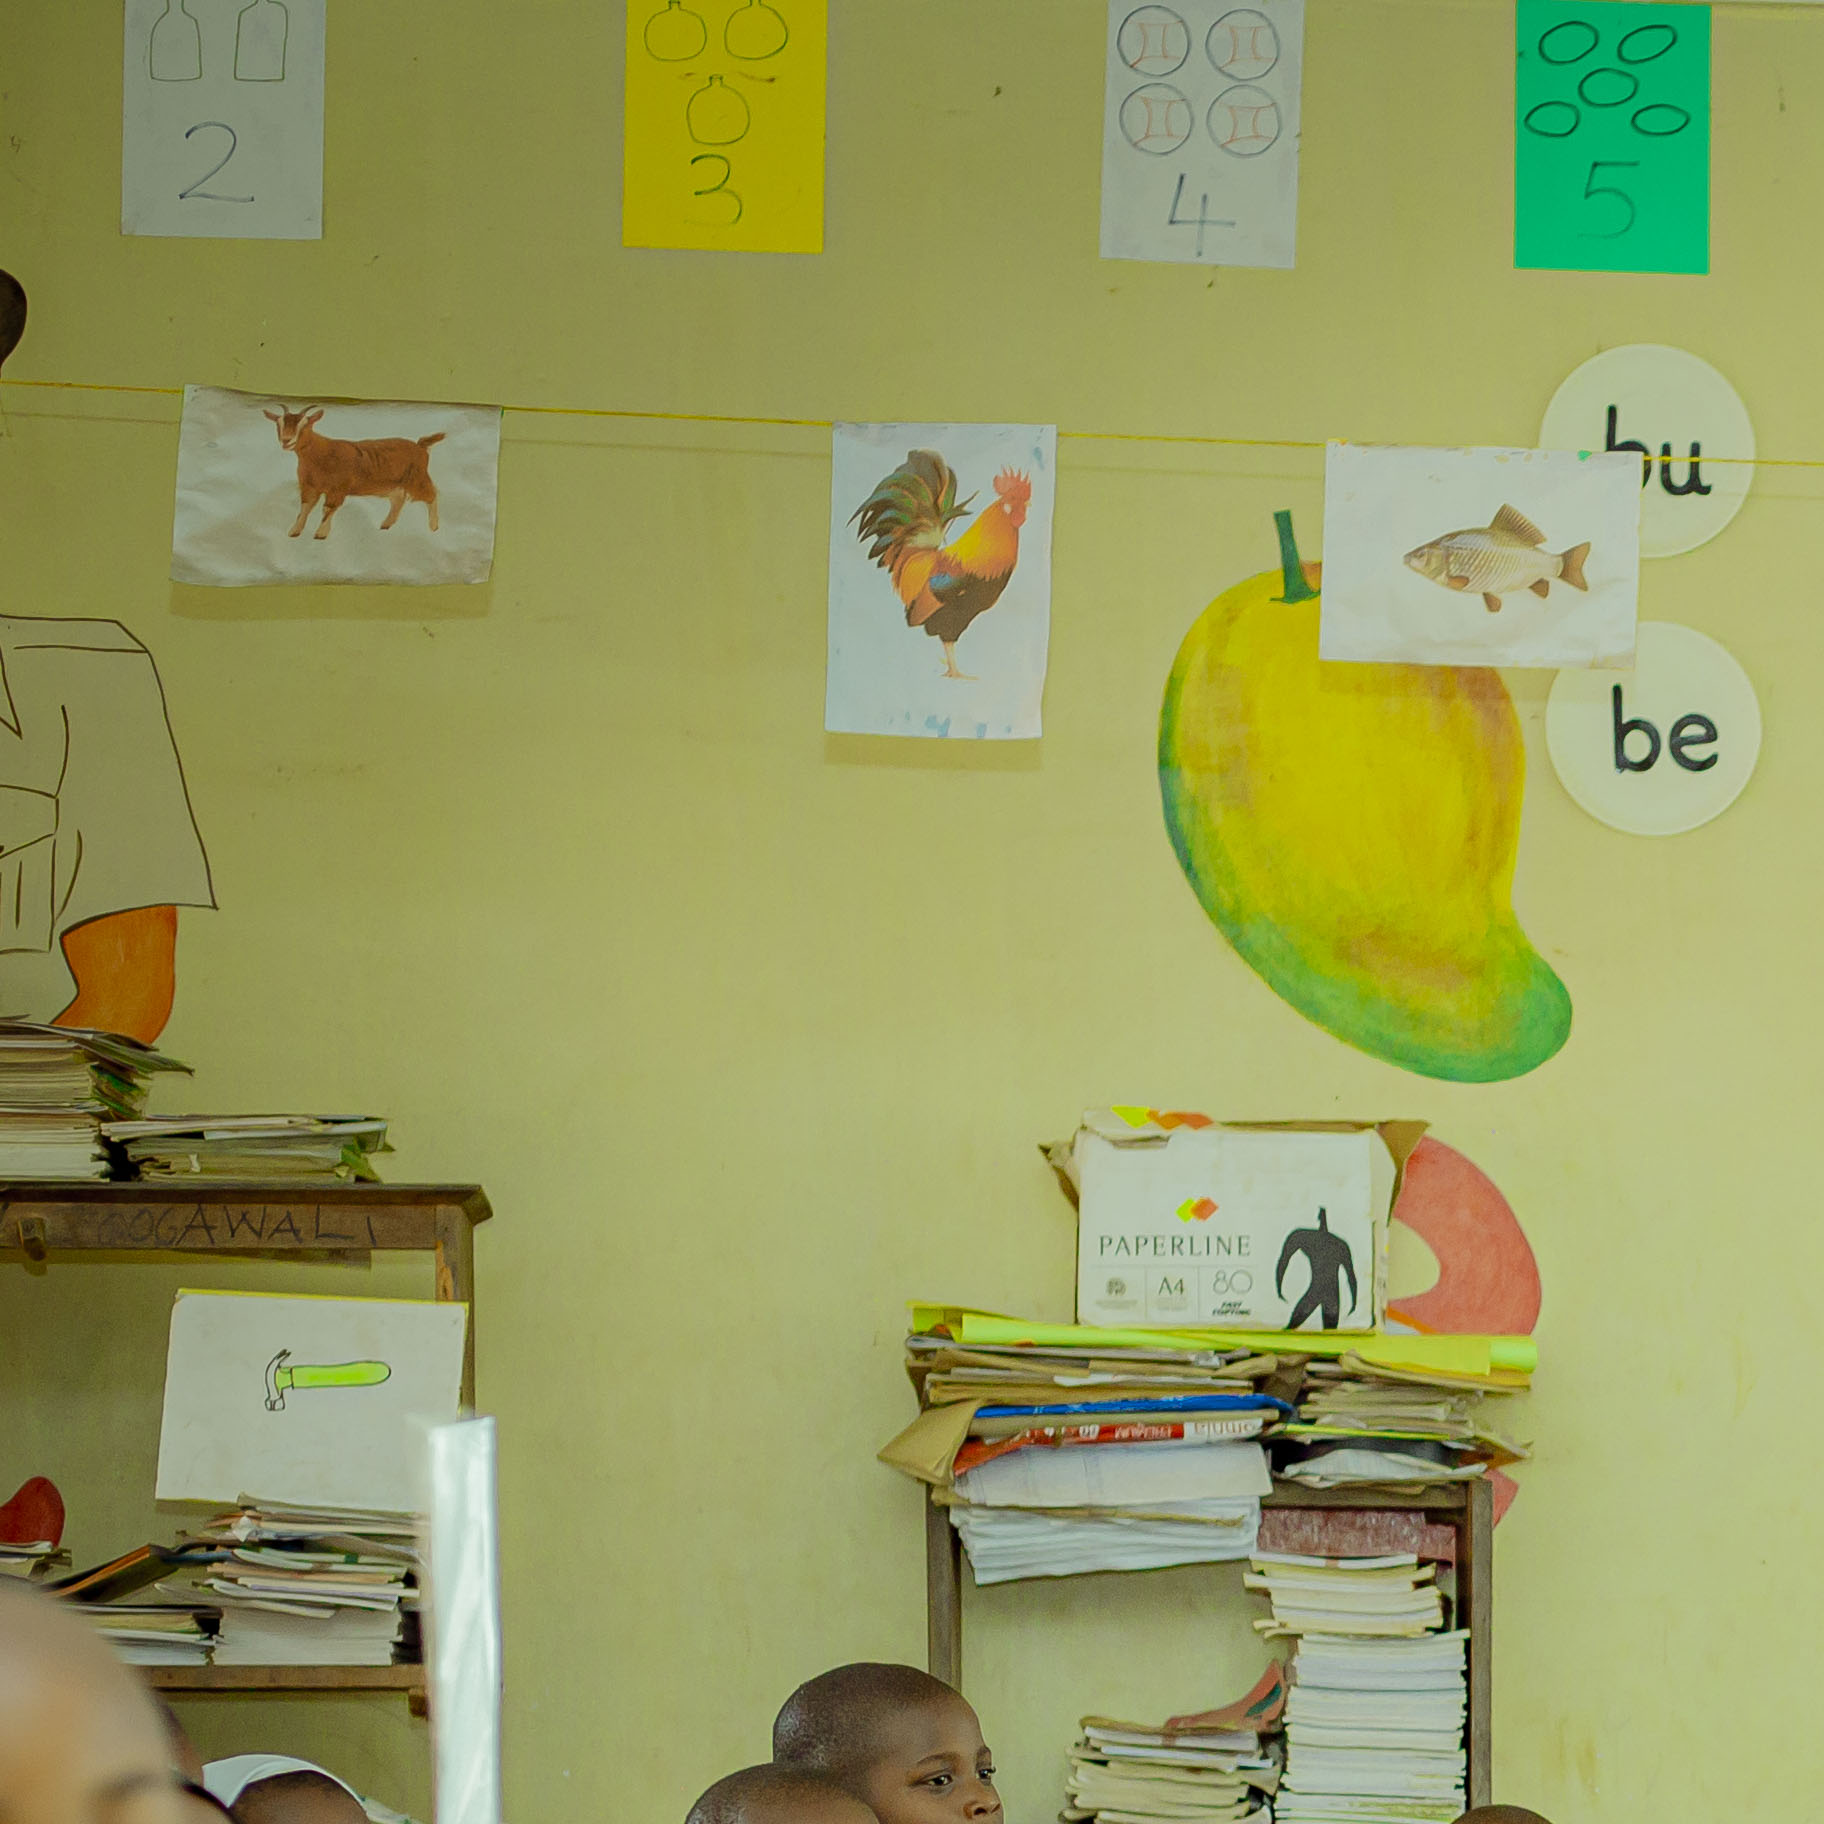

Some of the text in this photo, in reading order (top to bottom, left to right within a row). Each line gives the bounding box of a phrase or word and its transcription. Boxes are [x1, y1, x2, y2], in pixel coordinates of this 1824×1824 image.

[179, 121, 254, 202] 2
[690, 154, 742, 226] 3
[1167, 173, 1236, 257] 4
[1578, 162, 1640, 239] 5
[1612, 684, 1720, 773] be
[1100, 1235, 1252, 1257] PAPERLINE
[1157, 1269, 1253, 1296] A4 80
